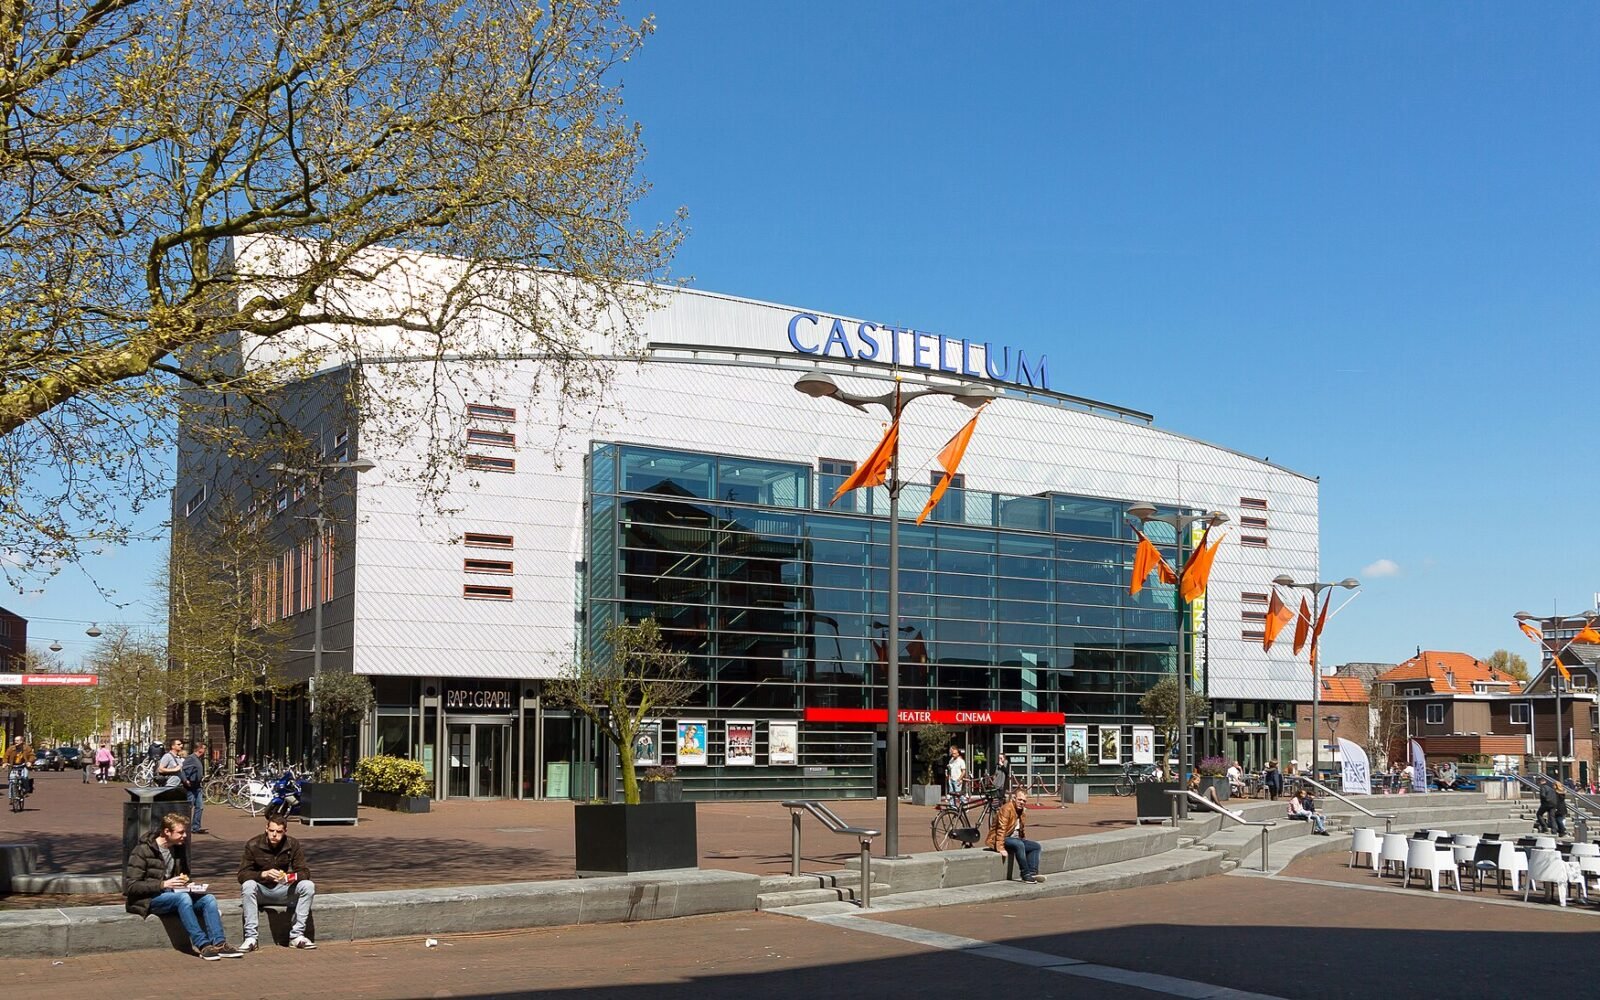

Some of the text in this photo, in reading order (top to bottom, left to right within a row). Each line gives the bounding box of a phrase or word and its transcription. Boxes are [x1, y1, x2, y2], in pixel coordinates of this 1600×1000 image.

[788, 313, 1050, 390] CASTELLUM
[898, 711, 992, 722] HEATER CINEMA
